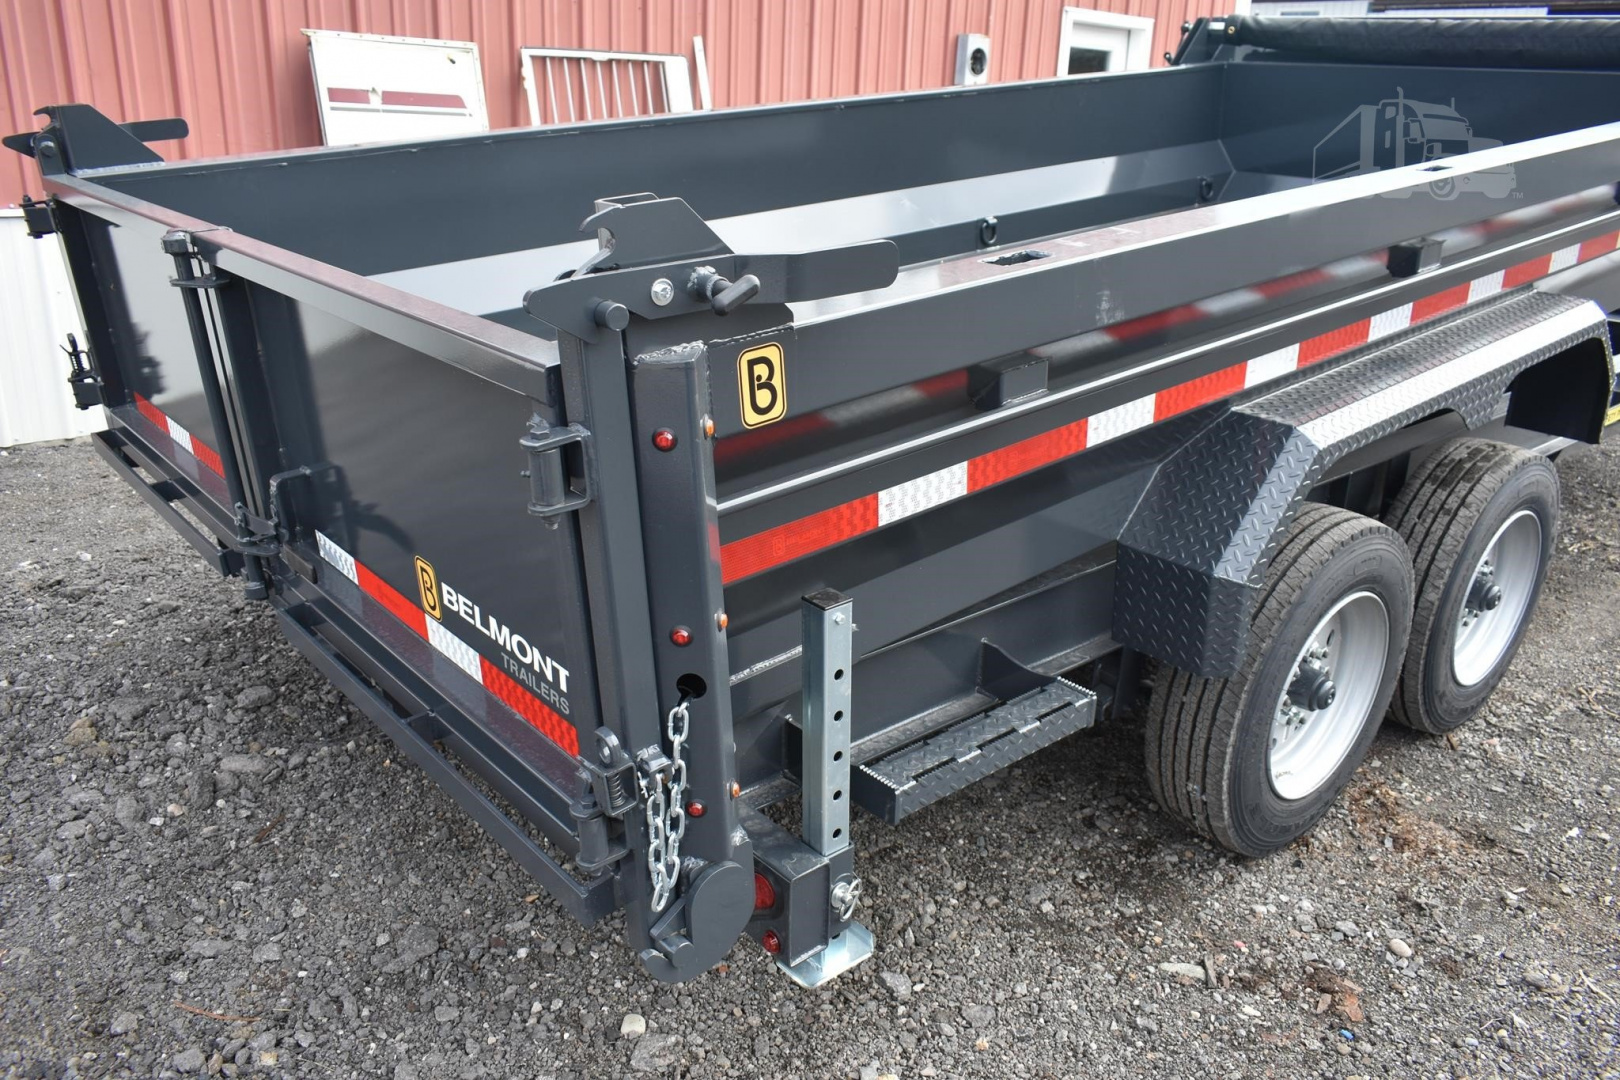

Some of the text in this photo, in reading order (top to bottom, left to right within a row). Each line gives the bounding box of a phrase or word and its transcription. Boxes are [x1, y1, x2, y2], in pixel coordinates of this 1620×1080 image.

[746, 355, 778, 416] B
[441, 582, 570, 693] BELMONT
[501, 652, 570, 715] TRAILERS
